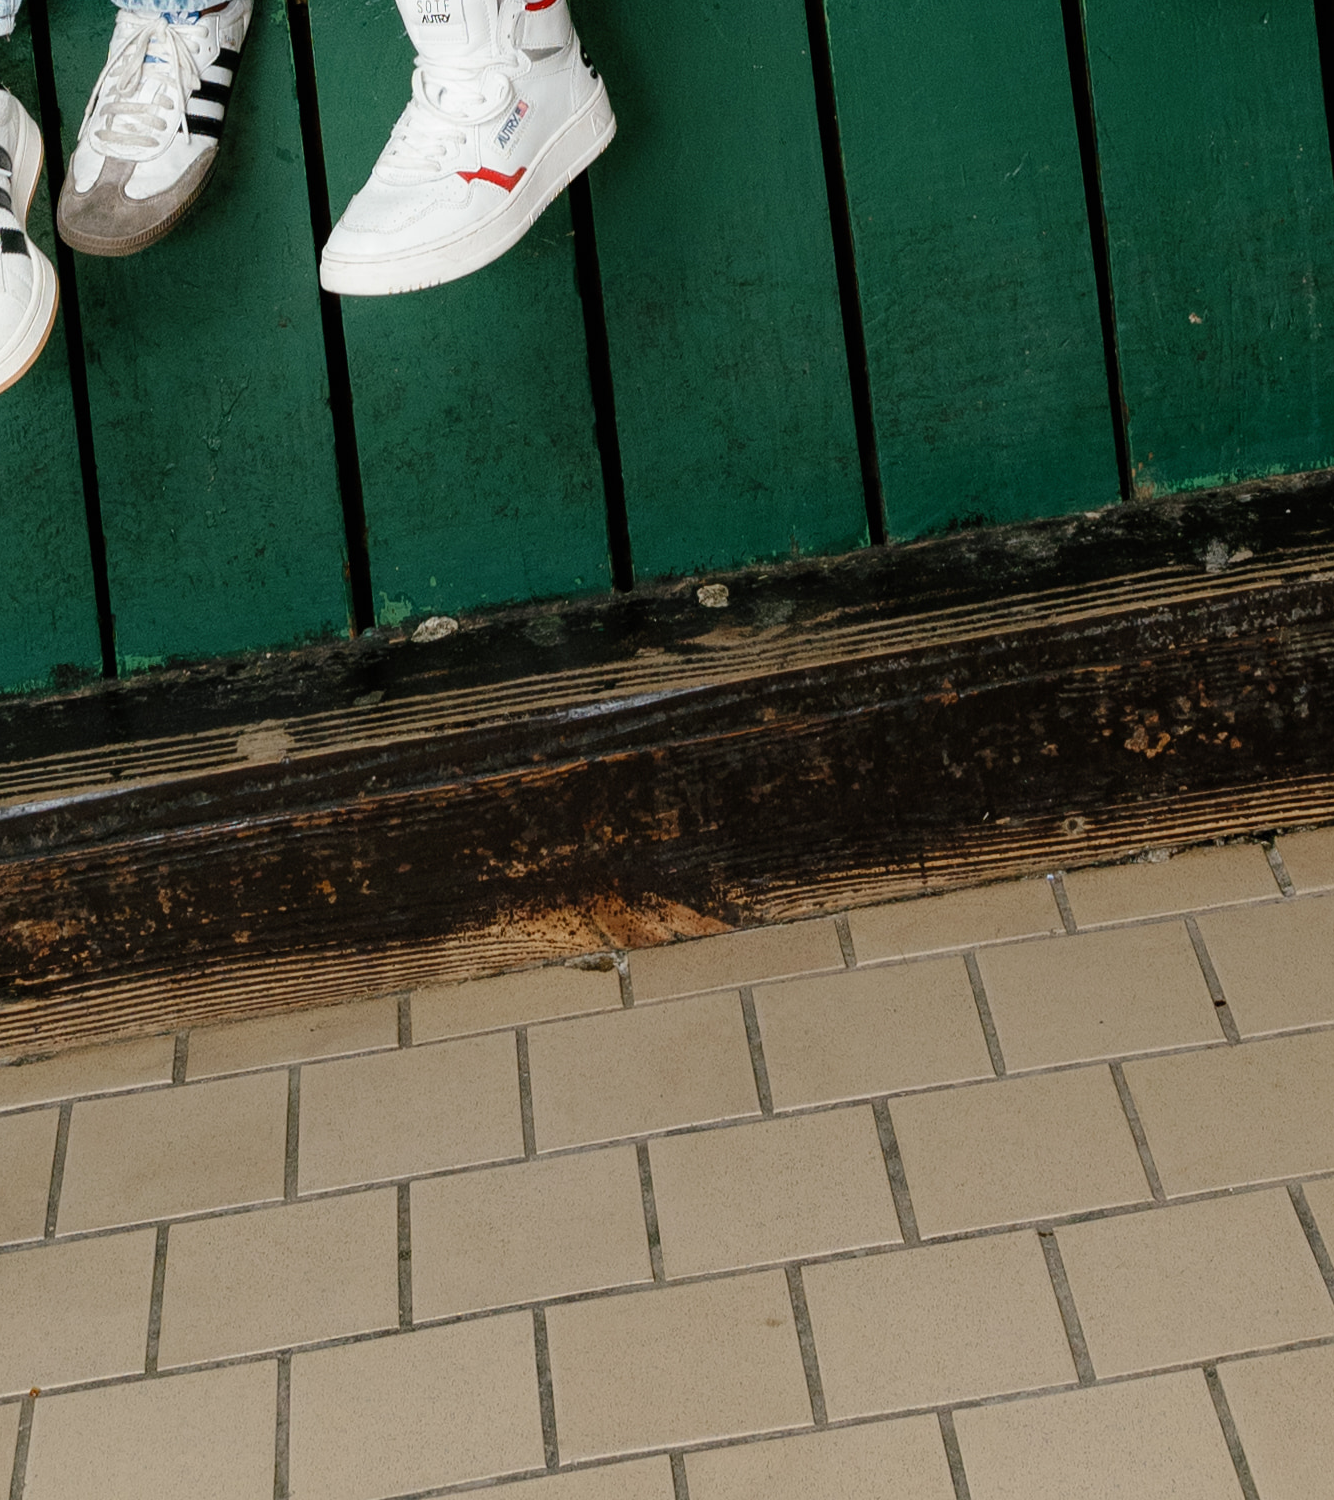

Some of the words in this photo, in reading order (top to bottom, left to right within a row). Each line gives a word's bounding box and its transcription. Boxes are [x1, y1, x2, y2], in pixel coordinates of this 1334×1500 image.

[417, 0, 449, 13] SOTF
[422, 13, 451, 24] AUTRY
[498, 112, 519, 149] AUTRY
